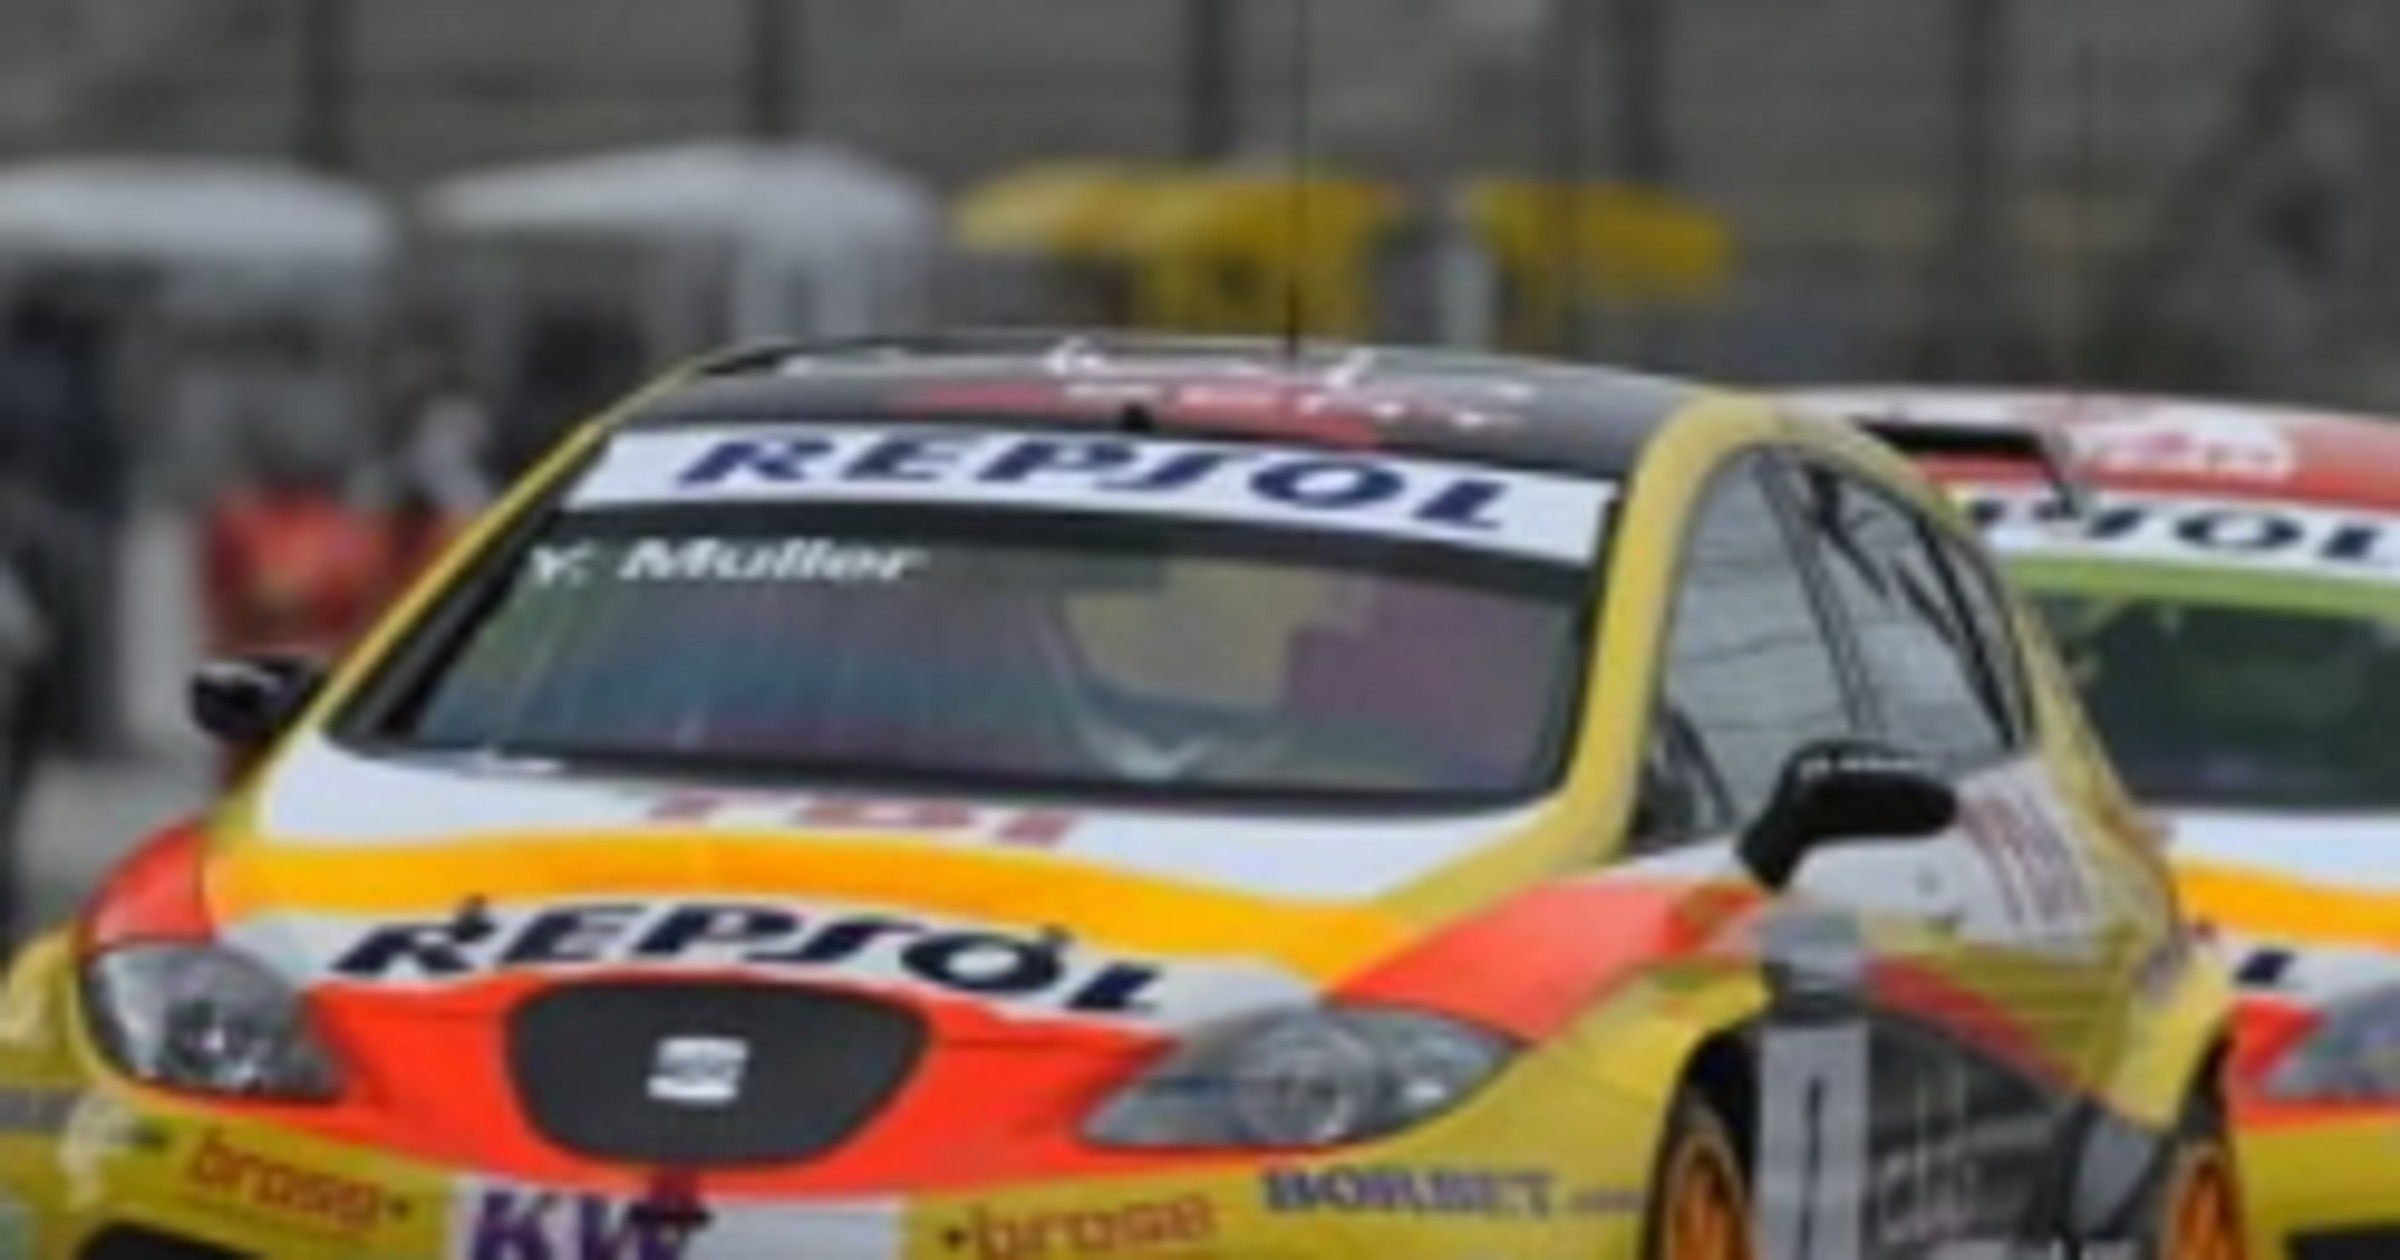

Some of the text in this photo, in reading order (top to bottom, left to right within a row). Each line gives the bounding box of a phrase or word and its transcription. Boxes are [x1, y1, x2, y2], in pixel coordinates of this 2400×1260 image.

[676, 436, 1514, 532] REPSOL
[617, 536, 930, 582] Muller
[333, 900, 1168, 1014] REPSOL
